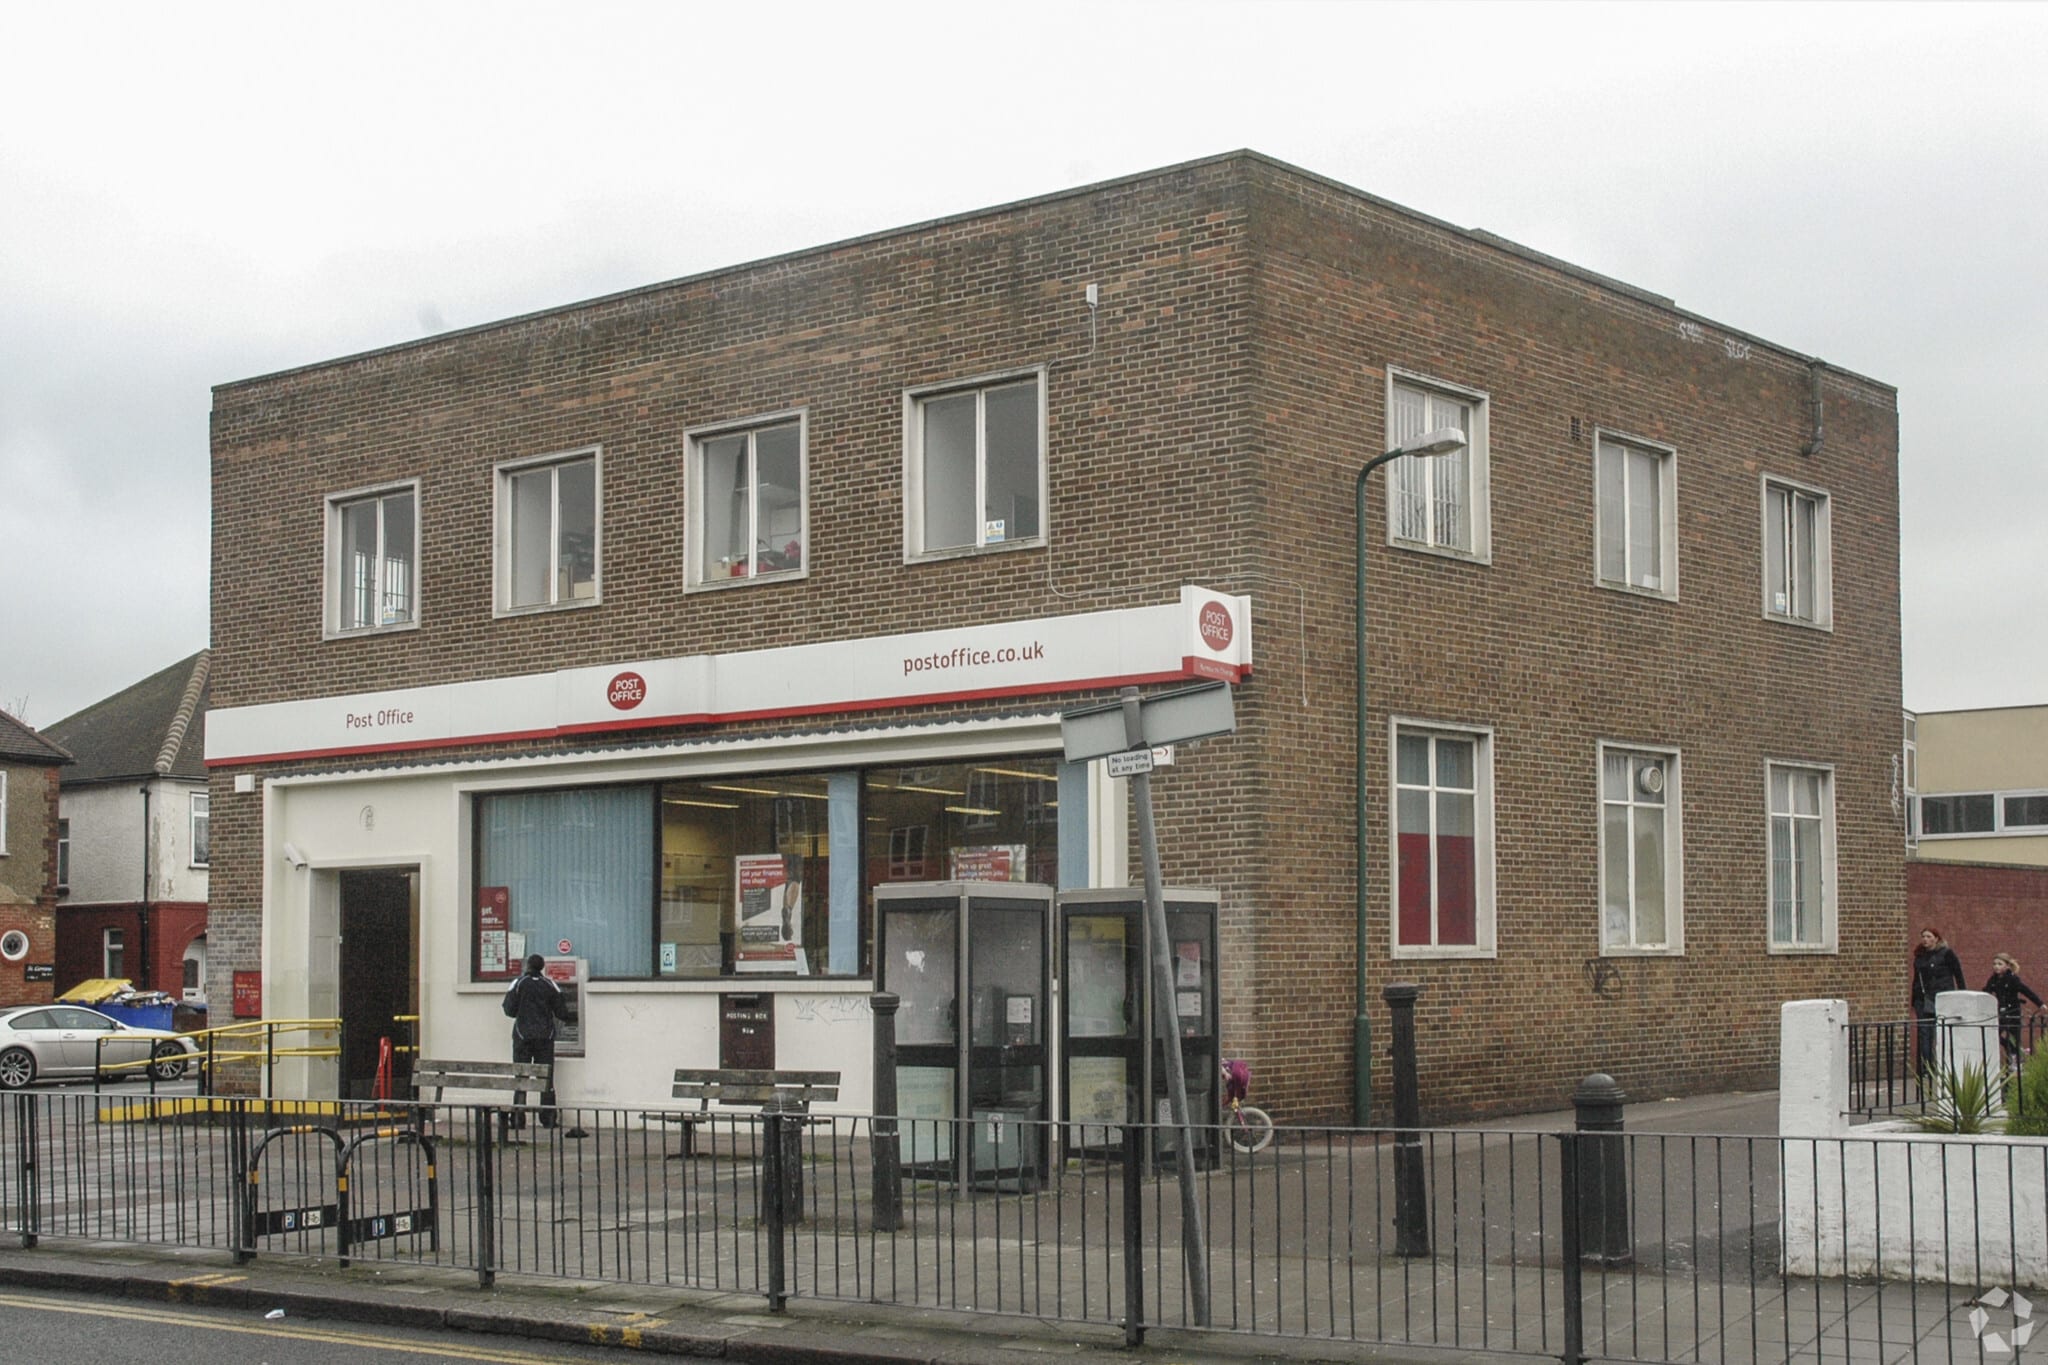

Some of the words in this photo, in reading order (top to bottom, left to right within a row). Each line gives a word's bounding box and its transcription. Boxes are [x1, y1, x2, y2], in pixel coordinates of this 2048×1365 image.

[1206, 610, 1226, 626] POST
[1201, 623, 1229, 641] OFFICE
[903, 640, 1044, 677] postoffice.co.uk
[615, 679, 639, 690] POST
[610, 689, 642, 702] OFFICE
[346, 713, 373, 729] Post
[377, 708, 414, 726] Office
[1123, 753, 1148, 763] loading
[1135, 762, 1150, 770] time
[481, 906, 492, 916] get
